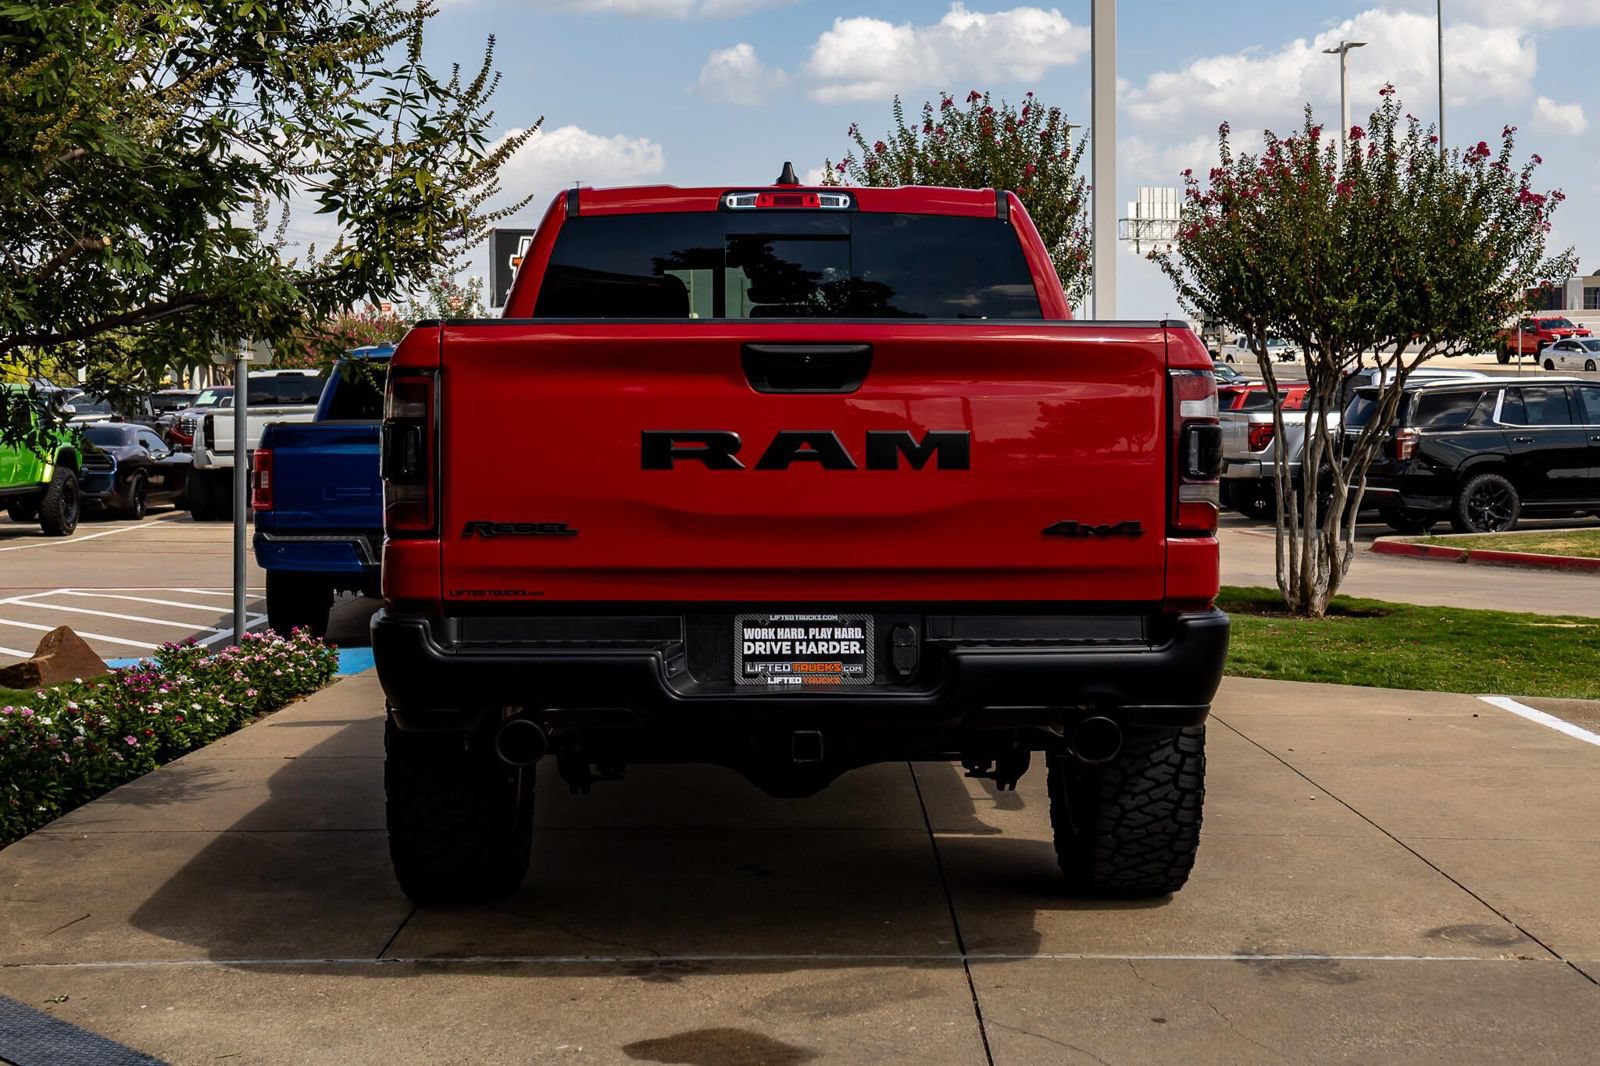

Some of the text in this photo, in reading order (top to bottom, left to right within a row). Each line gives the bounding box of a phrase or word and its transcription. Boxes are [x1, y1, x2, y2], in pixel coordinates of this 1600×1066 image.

[641, 430, 971, 470] RAM
[462, 521, 579, 537] REBEL
[743, 627, 865, 640] WORK HARD. PLAY HARD.
[743, 641, 865, 655] DRIVE HARDER.
